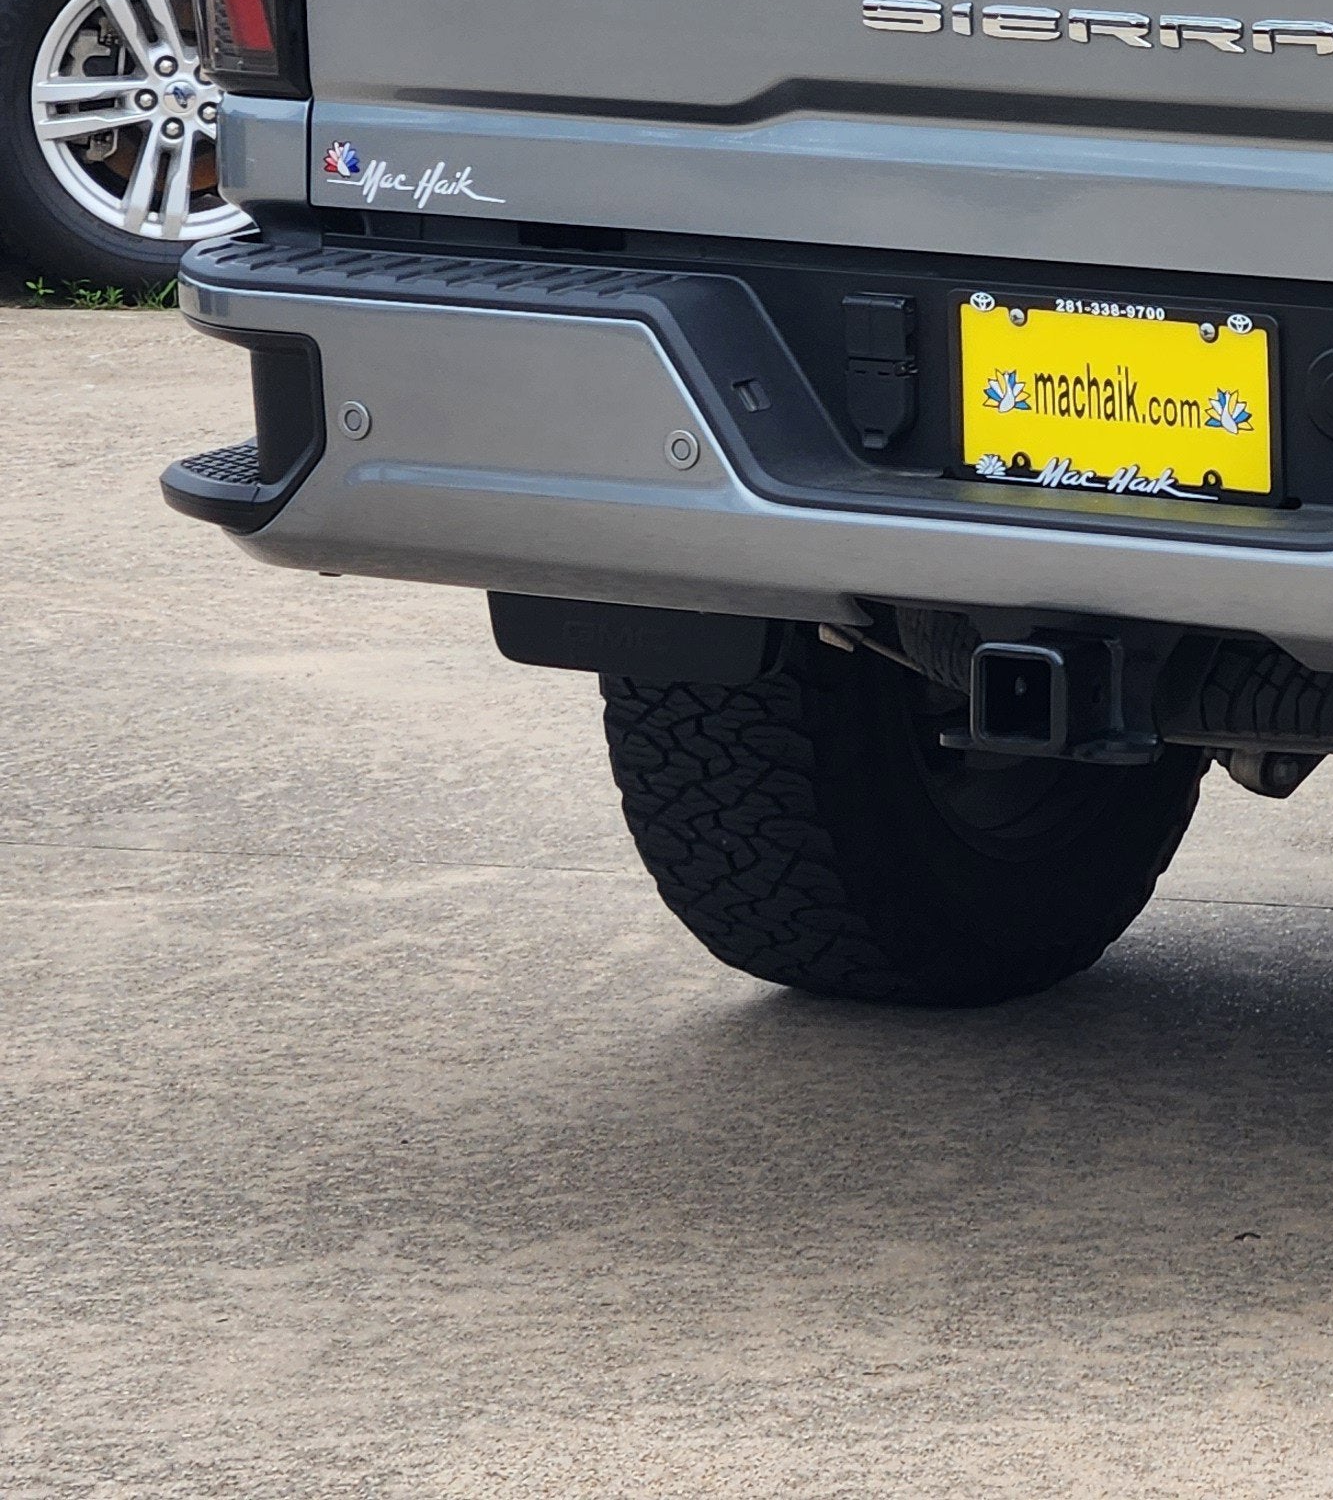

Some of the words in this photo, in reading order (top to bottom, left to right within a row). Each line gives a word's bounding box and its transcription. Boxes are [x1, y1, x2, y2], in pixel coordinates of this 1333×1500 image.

[347, 159, 414, 204] Mac
[412, 161, 490, 209] Haik
[1055, 298, 1166, 321] 281-338-9700
[1034, 362, 1201, 429] machaik.com
[1027, 457, 1104, 488] Mac
[1105, 463, 1195, 498] Haik
